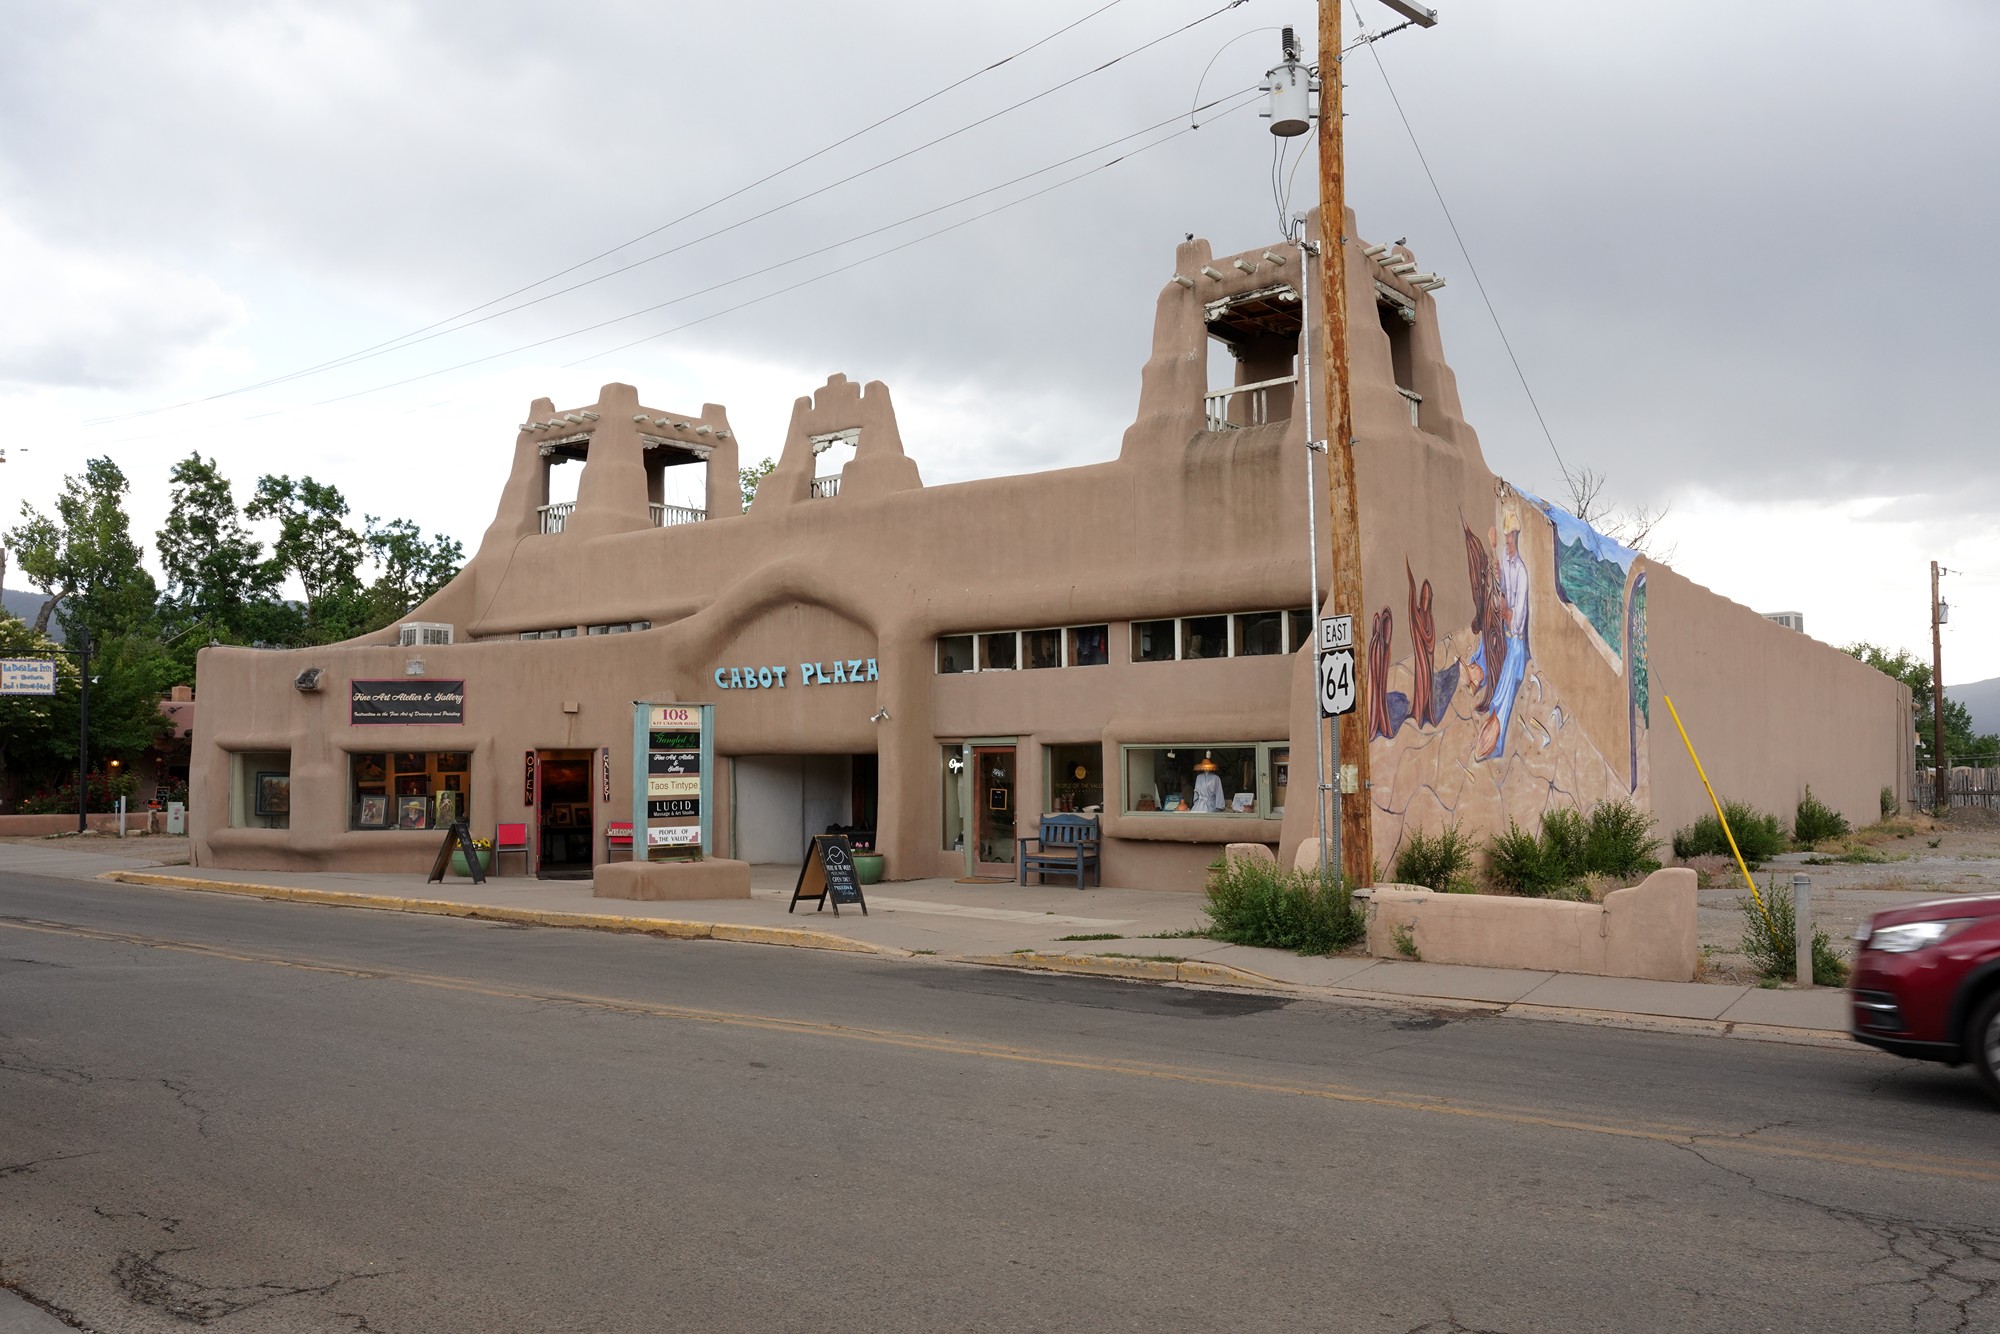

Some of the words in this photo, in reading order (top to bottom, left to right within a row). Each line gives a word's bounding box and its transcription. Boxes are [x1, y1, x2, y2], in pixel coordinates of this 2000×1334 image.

[1326, 623, 1347, 642] EAST
[40, 664, 52, 672] Inn
[714, 666, 787, 689] CABOT
[800, 658, 878, 686] PLAZA
[1326, 662, 1349, 700] 64
[352, 692, 371, 702] Fine
[372, 692, 390, 701] Art
[392, 692, 422, 702] Atelier
[424, 692, 432, 702] &
[434, 692, 464, 704] Gallery
[663, 708, 688, 720] 108
[654, 732, 688, 746] Tangled
[668, 765, 685, 774] Gallery
[948, 758, 963, 774] Ope
[526, 756, 534, 802] OPEN
[650, 781, 669, 790] Taos
[670, 780, 698, 791] Tintype
[656, 800, 691, 812] LUCID
